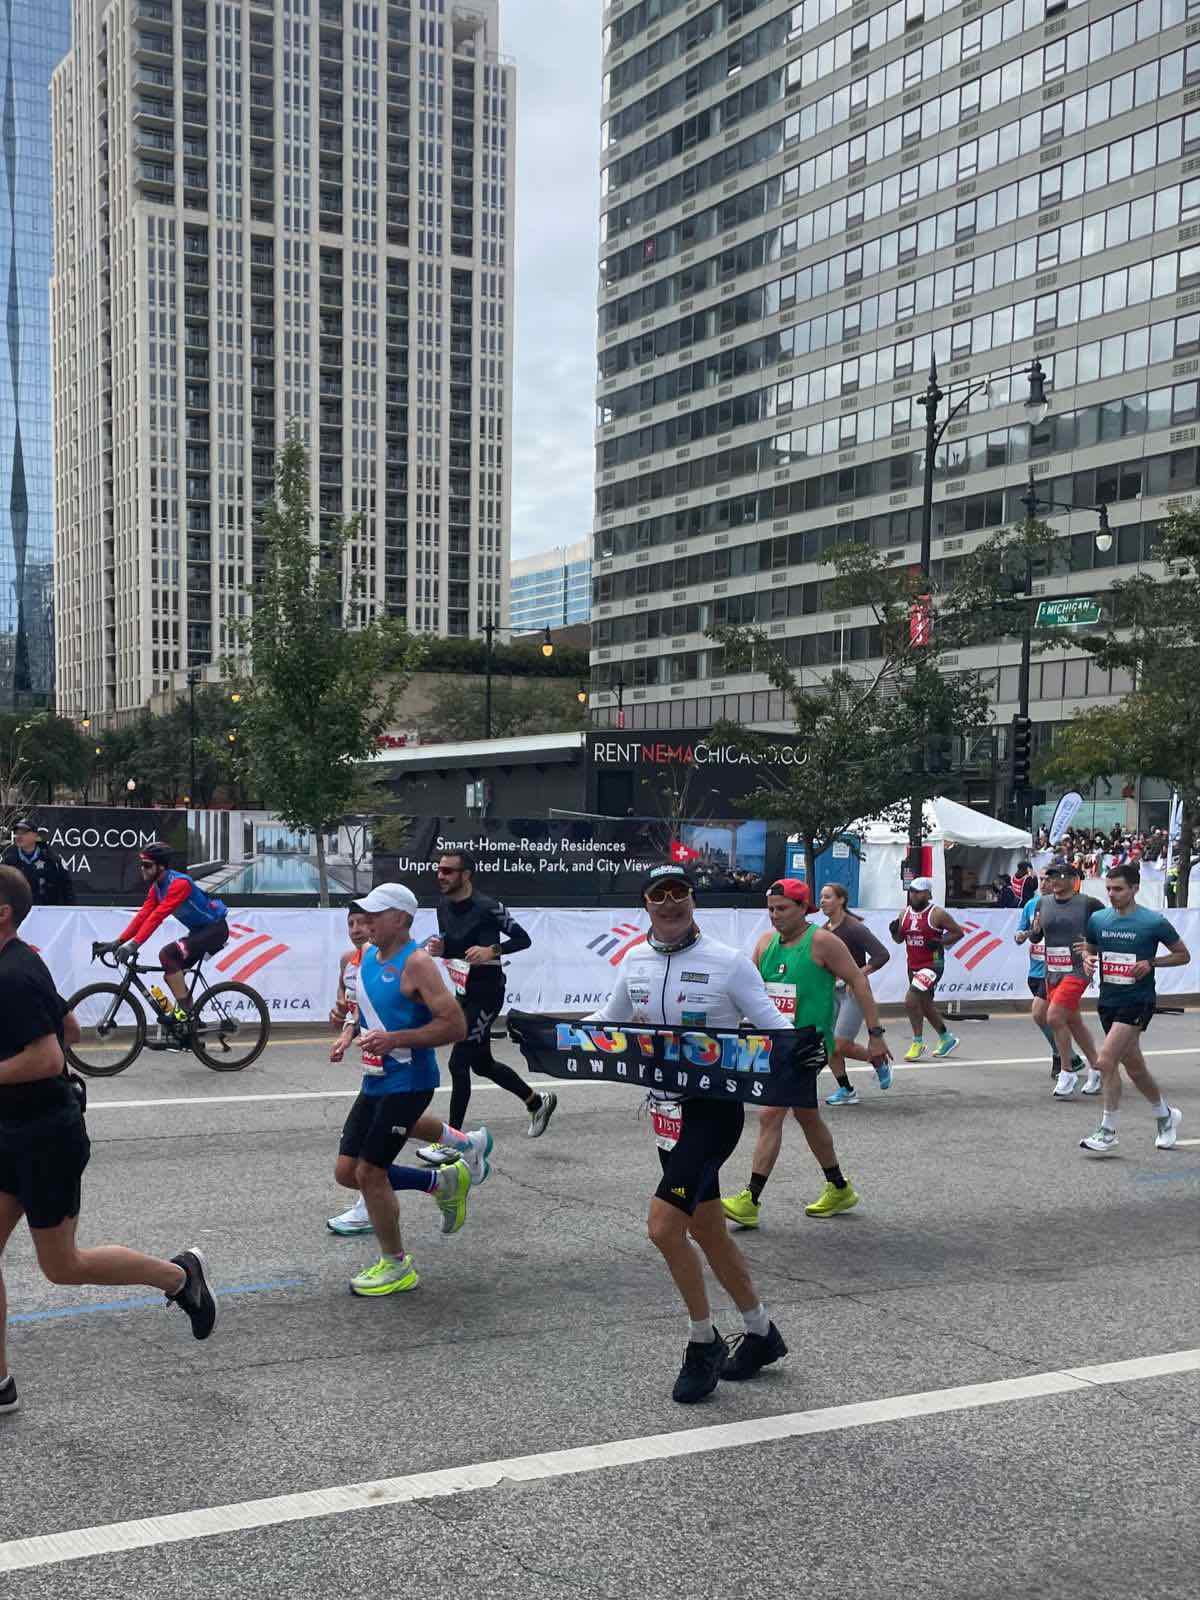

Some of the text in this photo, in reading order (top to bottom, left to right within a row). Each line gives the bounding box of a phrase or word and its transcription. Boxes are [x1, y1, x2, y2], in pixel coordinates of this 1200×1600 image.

[1047, 601, 1090, 615] MICHIGAN
[594, 743, 811, 766] RENTNEMACHICAGO.CO
[436, 837, 626, 855] Smart-Home-Ready Residences
[399, 857, 653, 875] Unpreted Lake, Park, and City View
[949, 983, 963, 992] OF
[966, 982, 1014, 992] AMERICA
[564, 992, 602, 1004] BANK
[556, 1023, 774, 1073] AUTISM
[566, 1058, 764, 1097] awareness
